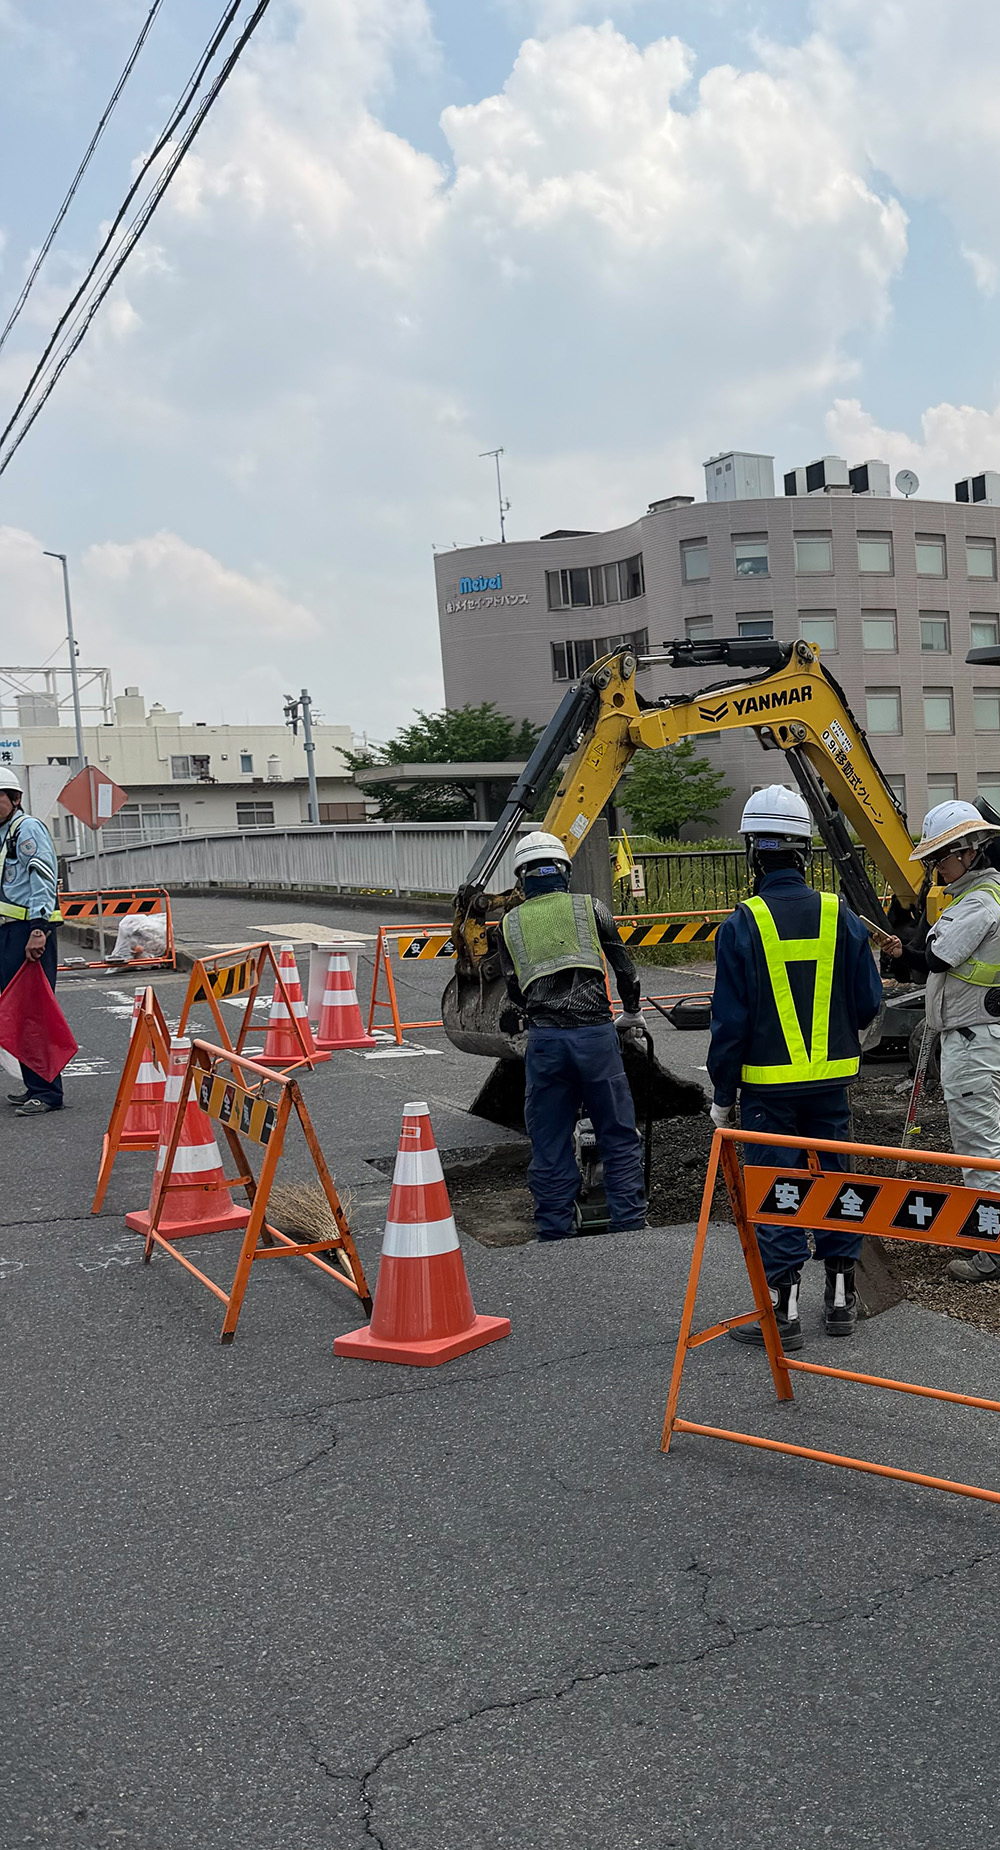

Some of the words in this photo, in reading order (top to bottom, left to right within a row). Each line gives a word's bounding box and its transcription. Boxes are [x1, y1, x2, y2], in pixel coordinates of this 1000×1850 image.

[459, 573, 502, 595] Meisei
[733, 685, 813, 716] YANMAR
[835, 749, 884, 824] 移動式クレーン
